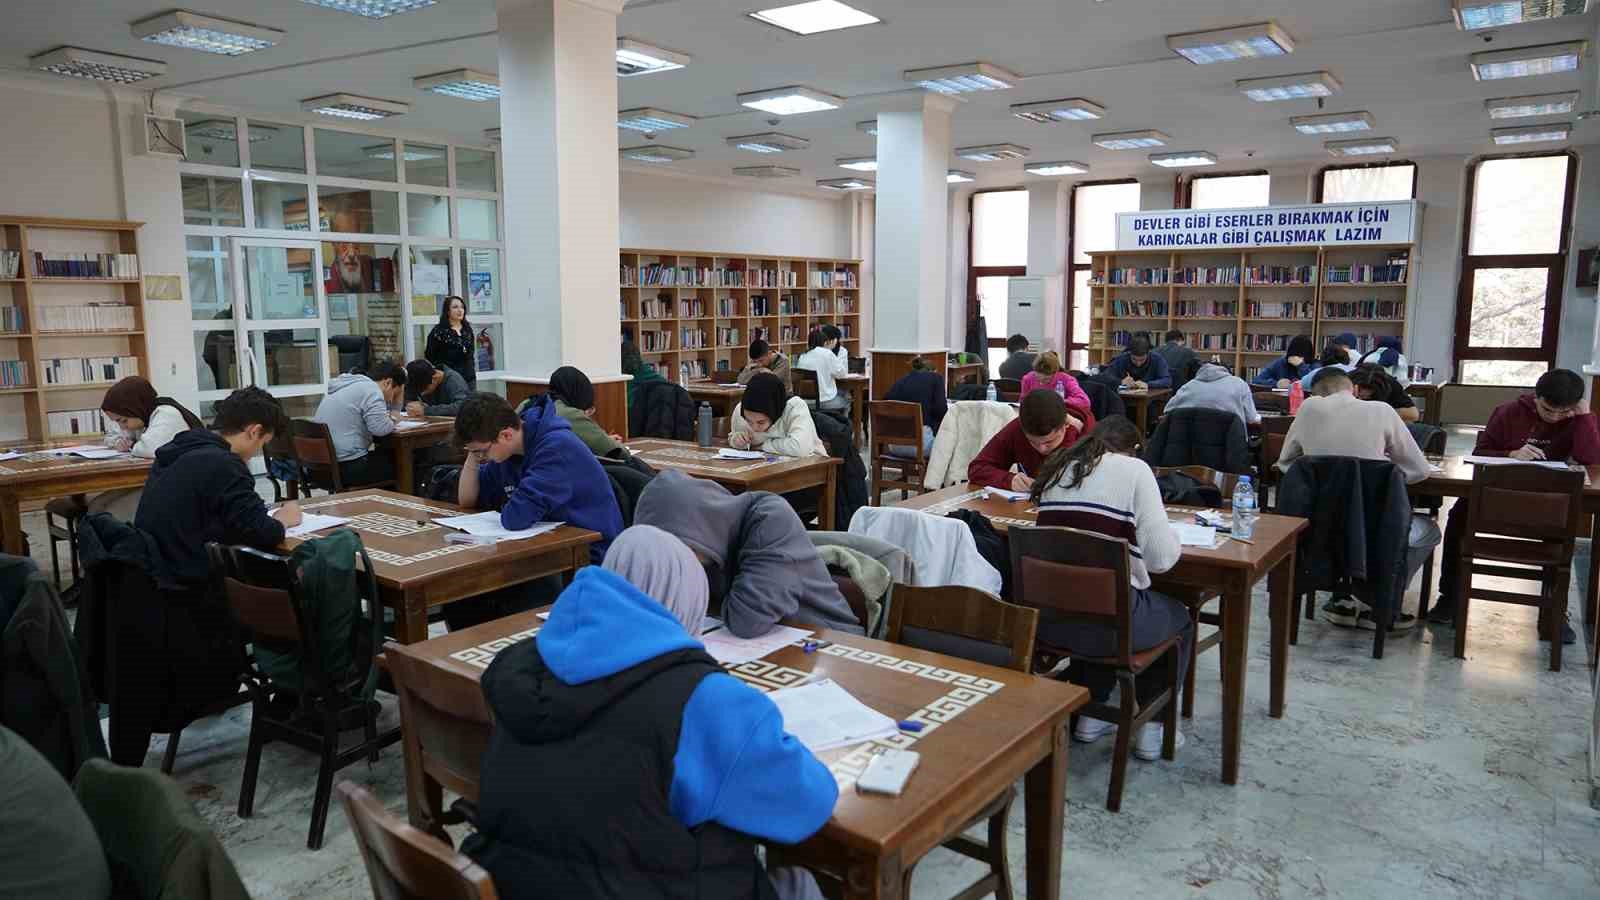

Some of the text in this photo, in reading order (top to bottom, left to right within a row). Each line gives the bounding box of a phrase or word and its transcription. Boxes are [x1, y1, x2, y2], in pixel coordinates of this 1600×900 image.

[1134, 206, 1389, 230] DEVLER GİBİ ESERLER BIRAKMAK İÇİN
[1138, 227, 1382, 246] KARINCALAR GİBİ ÇALIŞMAK LAZIM
